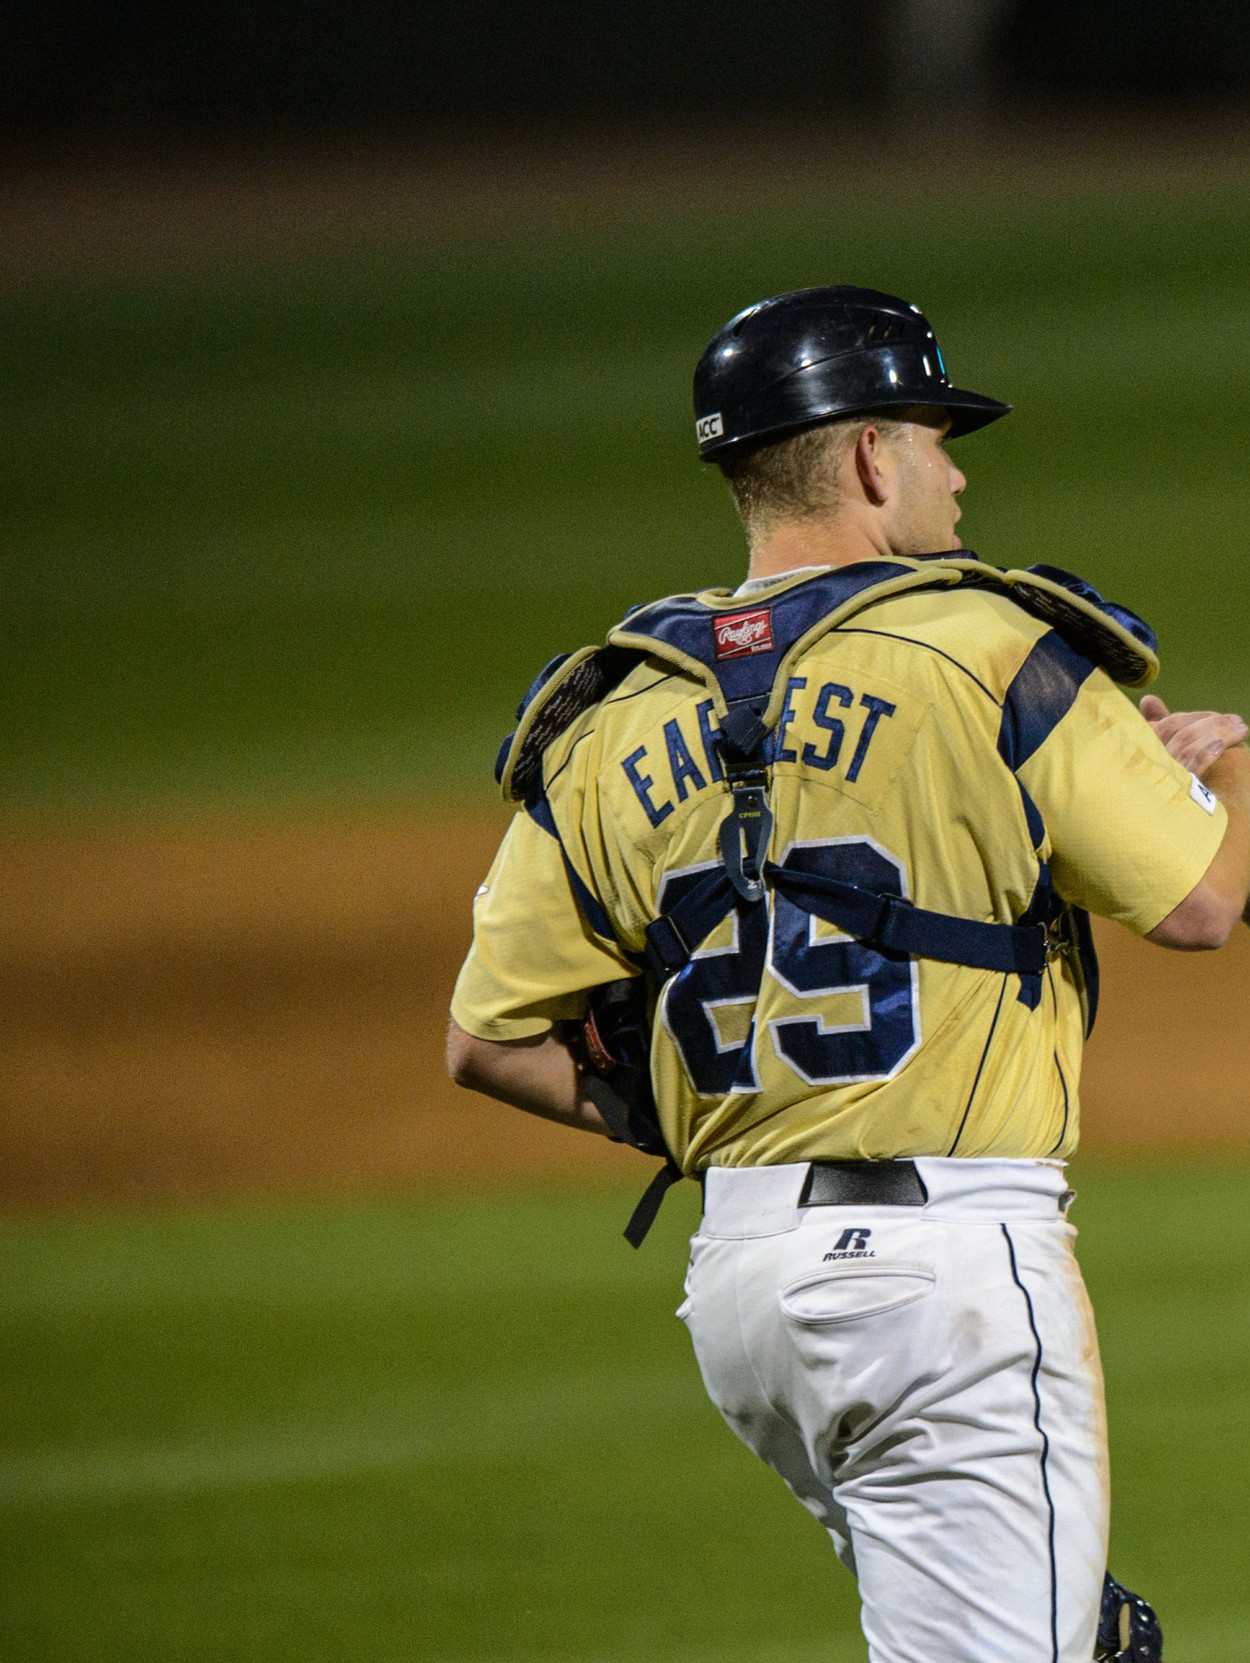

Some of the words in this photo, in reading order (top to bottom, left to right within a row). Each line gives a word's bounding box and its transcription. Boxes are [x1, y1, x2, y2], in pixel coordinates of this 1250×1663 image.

[718, 619, 768, 645] Rawlings
[621, 677, 897, 829] EAREST
[655, 834, 923, 1100] 29
[822, 1250, 876, 1262] RUSSELL
